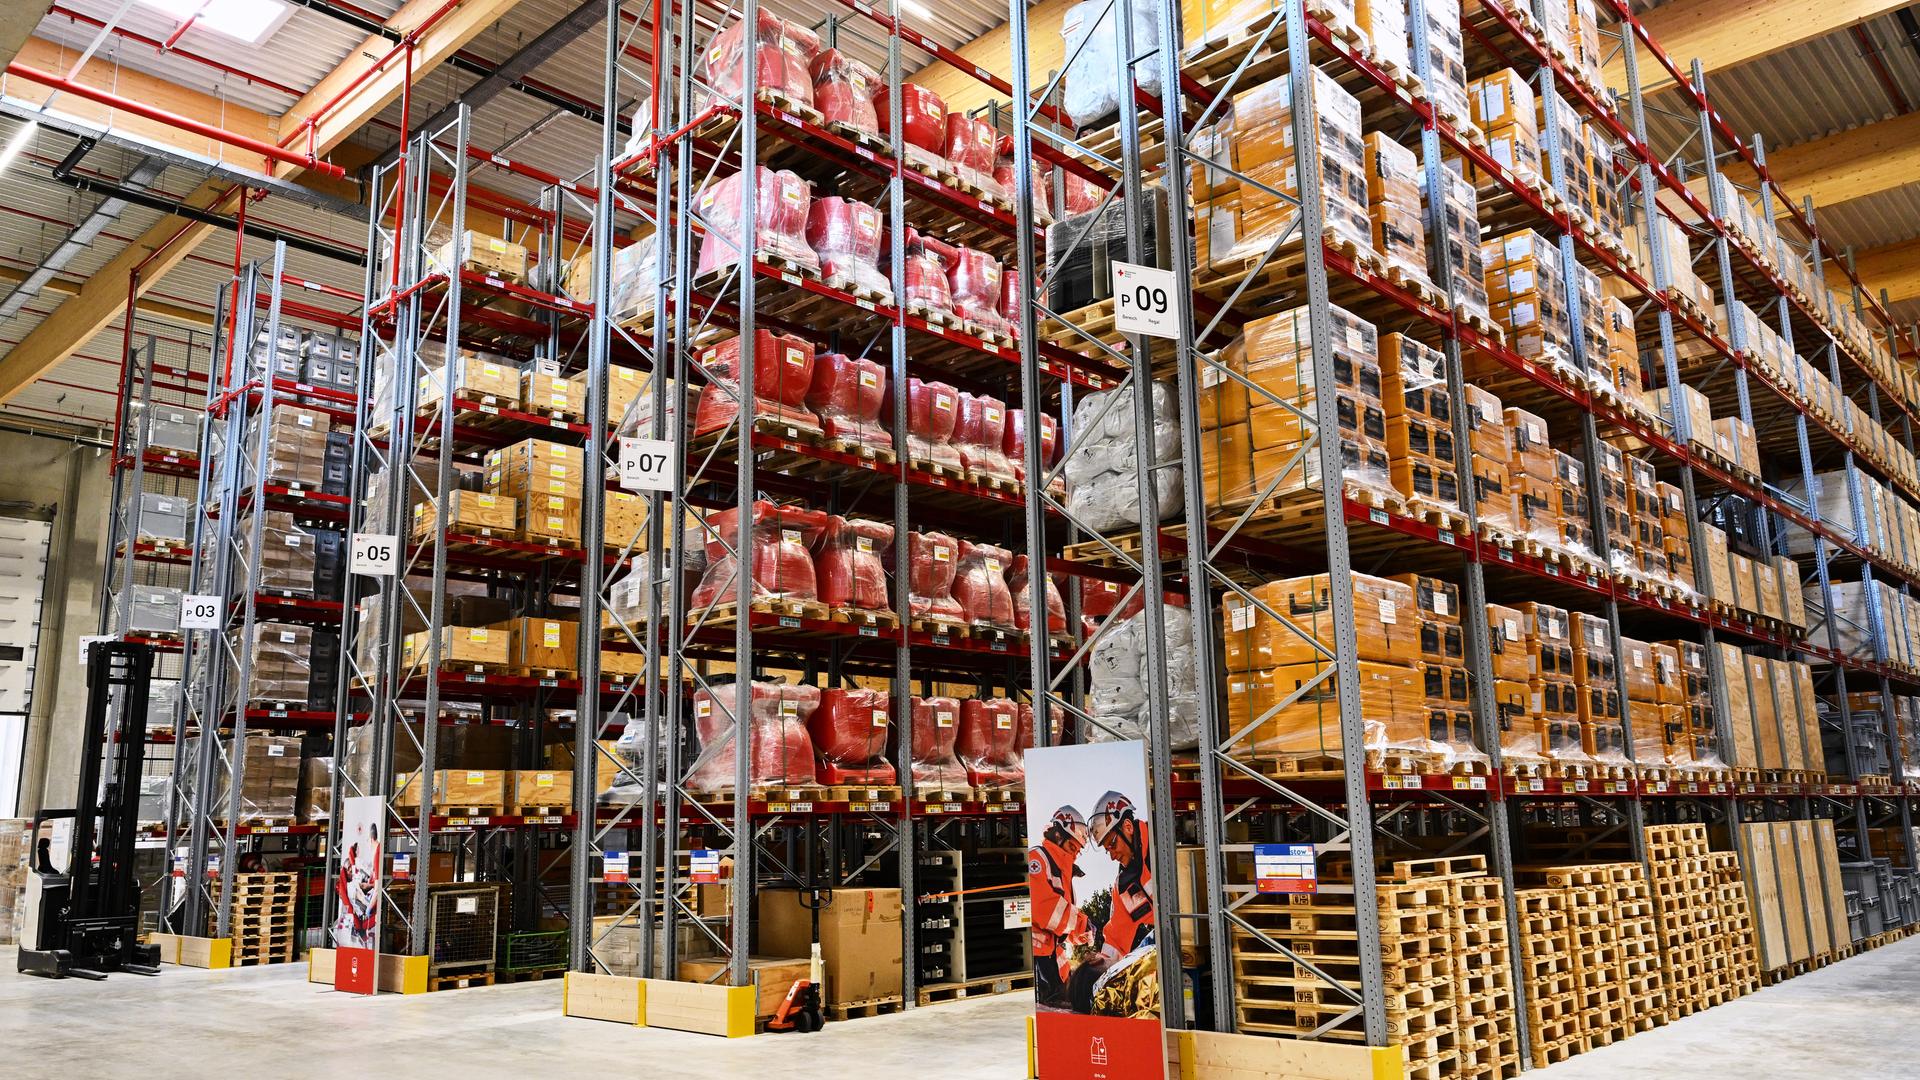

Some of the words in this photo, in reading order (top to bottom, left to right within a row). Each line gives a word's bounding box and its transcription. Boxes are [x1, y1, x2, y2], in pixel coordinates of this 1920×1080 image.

[1122, 293, 1131, 307] P
[1135, 285, 1168, 314] 09
[627, 460, 635, 470] P
[639, 453, 667, 473] 07
[356, 551, 365, 560] P
[367, 545, 391, 561] 05
[195, 605, 215, 618] 03
